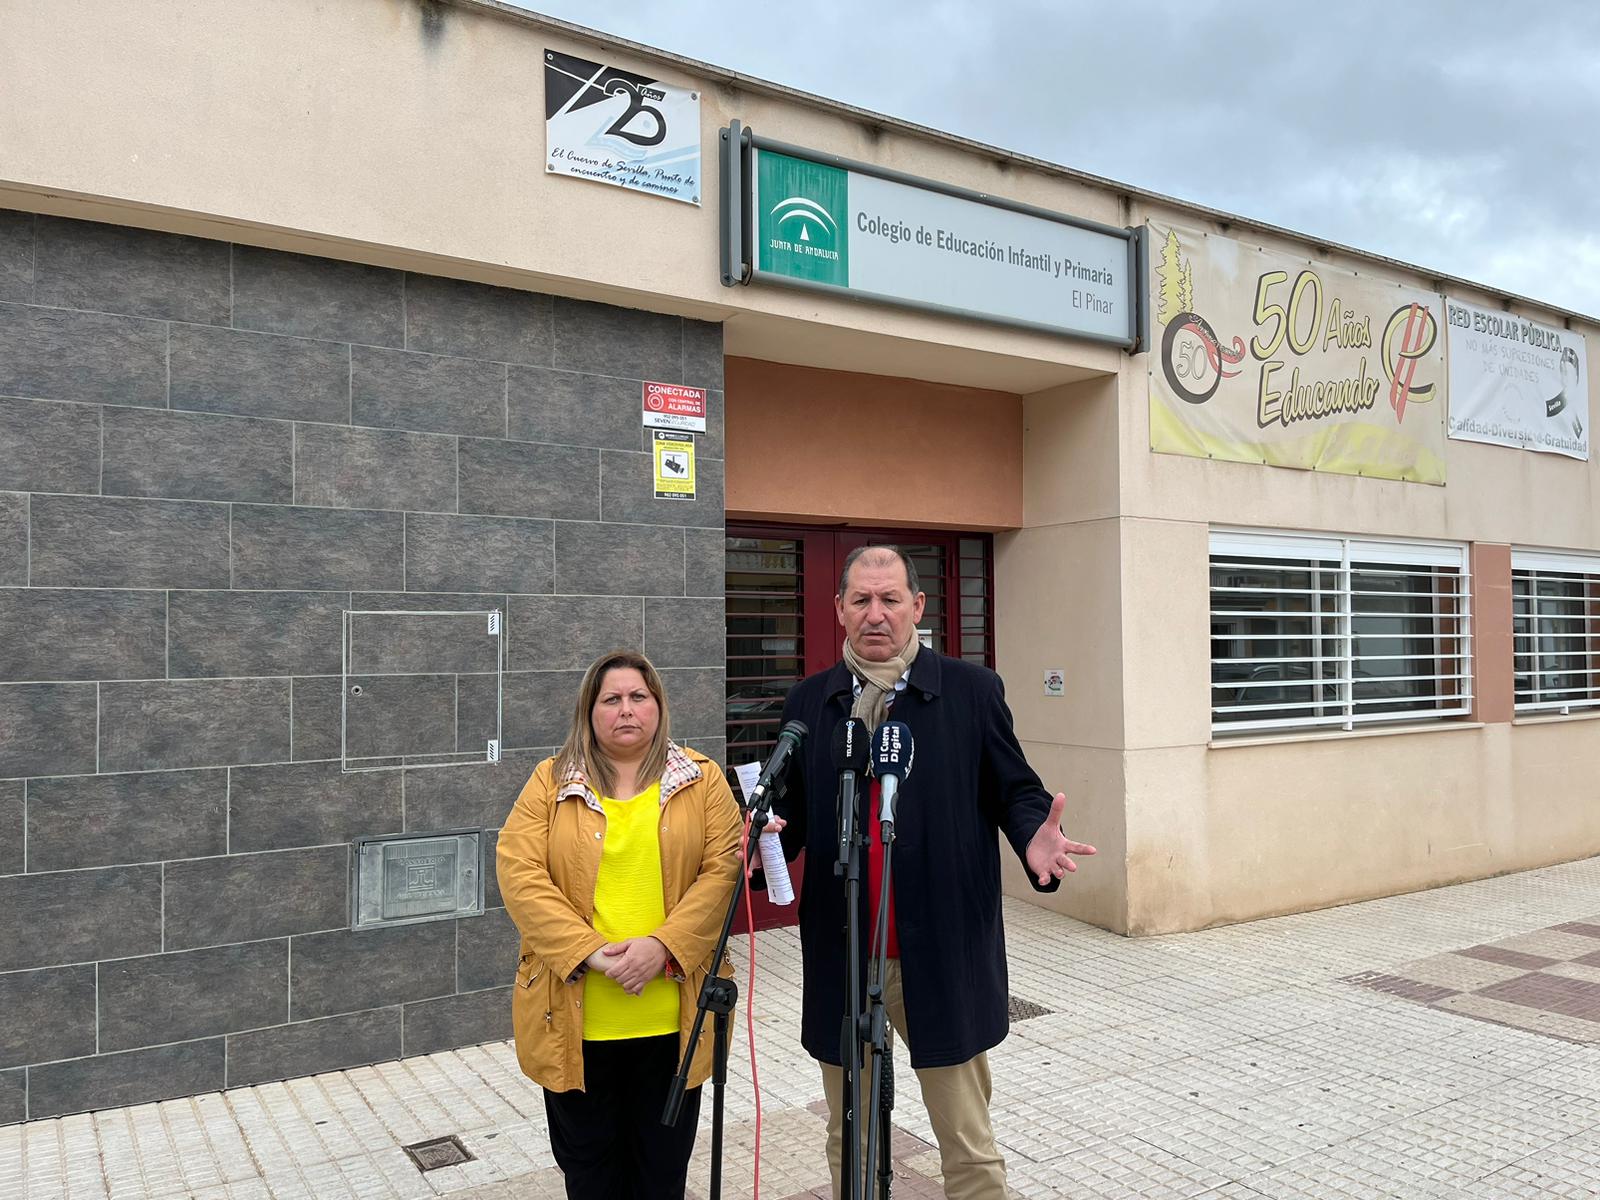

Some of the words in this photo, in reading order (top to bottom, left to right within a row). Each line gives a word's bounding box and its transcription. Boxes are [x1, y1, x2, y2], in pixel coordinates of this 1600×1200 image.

[640, 88, 661, 101] Años
[604, 78, 667, 146] 25
[551, 148, 563, 158] El
[567, 150, 598, 166] Cuervo
[602, 158, 613, 168] de
[616, 161, 651, 178] Sevilla,
[655, 169, 682, 183] Punto
[684, 175, 695, 186] de
[571, 166, 617, 182] encuentro
[620, 177, 626, 187] y
[628, 176, 640, 186] de
[642, 180, 679, 194] caminos
[770, 239, 792, 252] JUNTA
[794, 244, 803, 254] DE
[805, 245, 839, 261] ANDALUCIA
[857, 212, 912, 243] Colegio
[916, 225, 932, 246] de
[937, 230, 1004, 262] Educación
[1008, 245, 1051, 273] Infantil
[1054, 259, 1061, 278] y
[1065, 258, 1113, 286] Primaria
[1072, 290, 1081, 309] El
[1086, 293, 1114, 316] Pinar
[1250, 270, 1323, 361] 50
[1323, 297, 1372, 352] Años
[1448, 304, 1471, 329] RED
[1474, 311, 1520, 342] ESCOLAR
[1520, 322, 1563, 353] PÚBLICA
[1176, 341, 1208, 380] 50
[1465, 340, 1478, 350] NO
[1481, 339, 1498, 356] MÁS
[1501, 346, 1555, 371] SUPRESIONES
[648, 384, 701, 399] CONECTADA
[1257, 356, 1380, 429] Educando
[668, 403, 702, 413] ALARMAS
[880, 726, 890, 752] Cuervo
[890, 726, 901, 763] Digital
[879, 753, 889, 763] El
